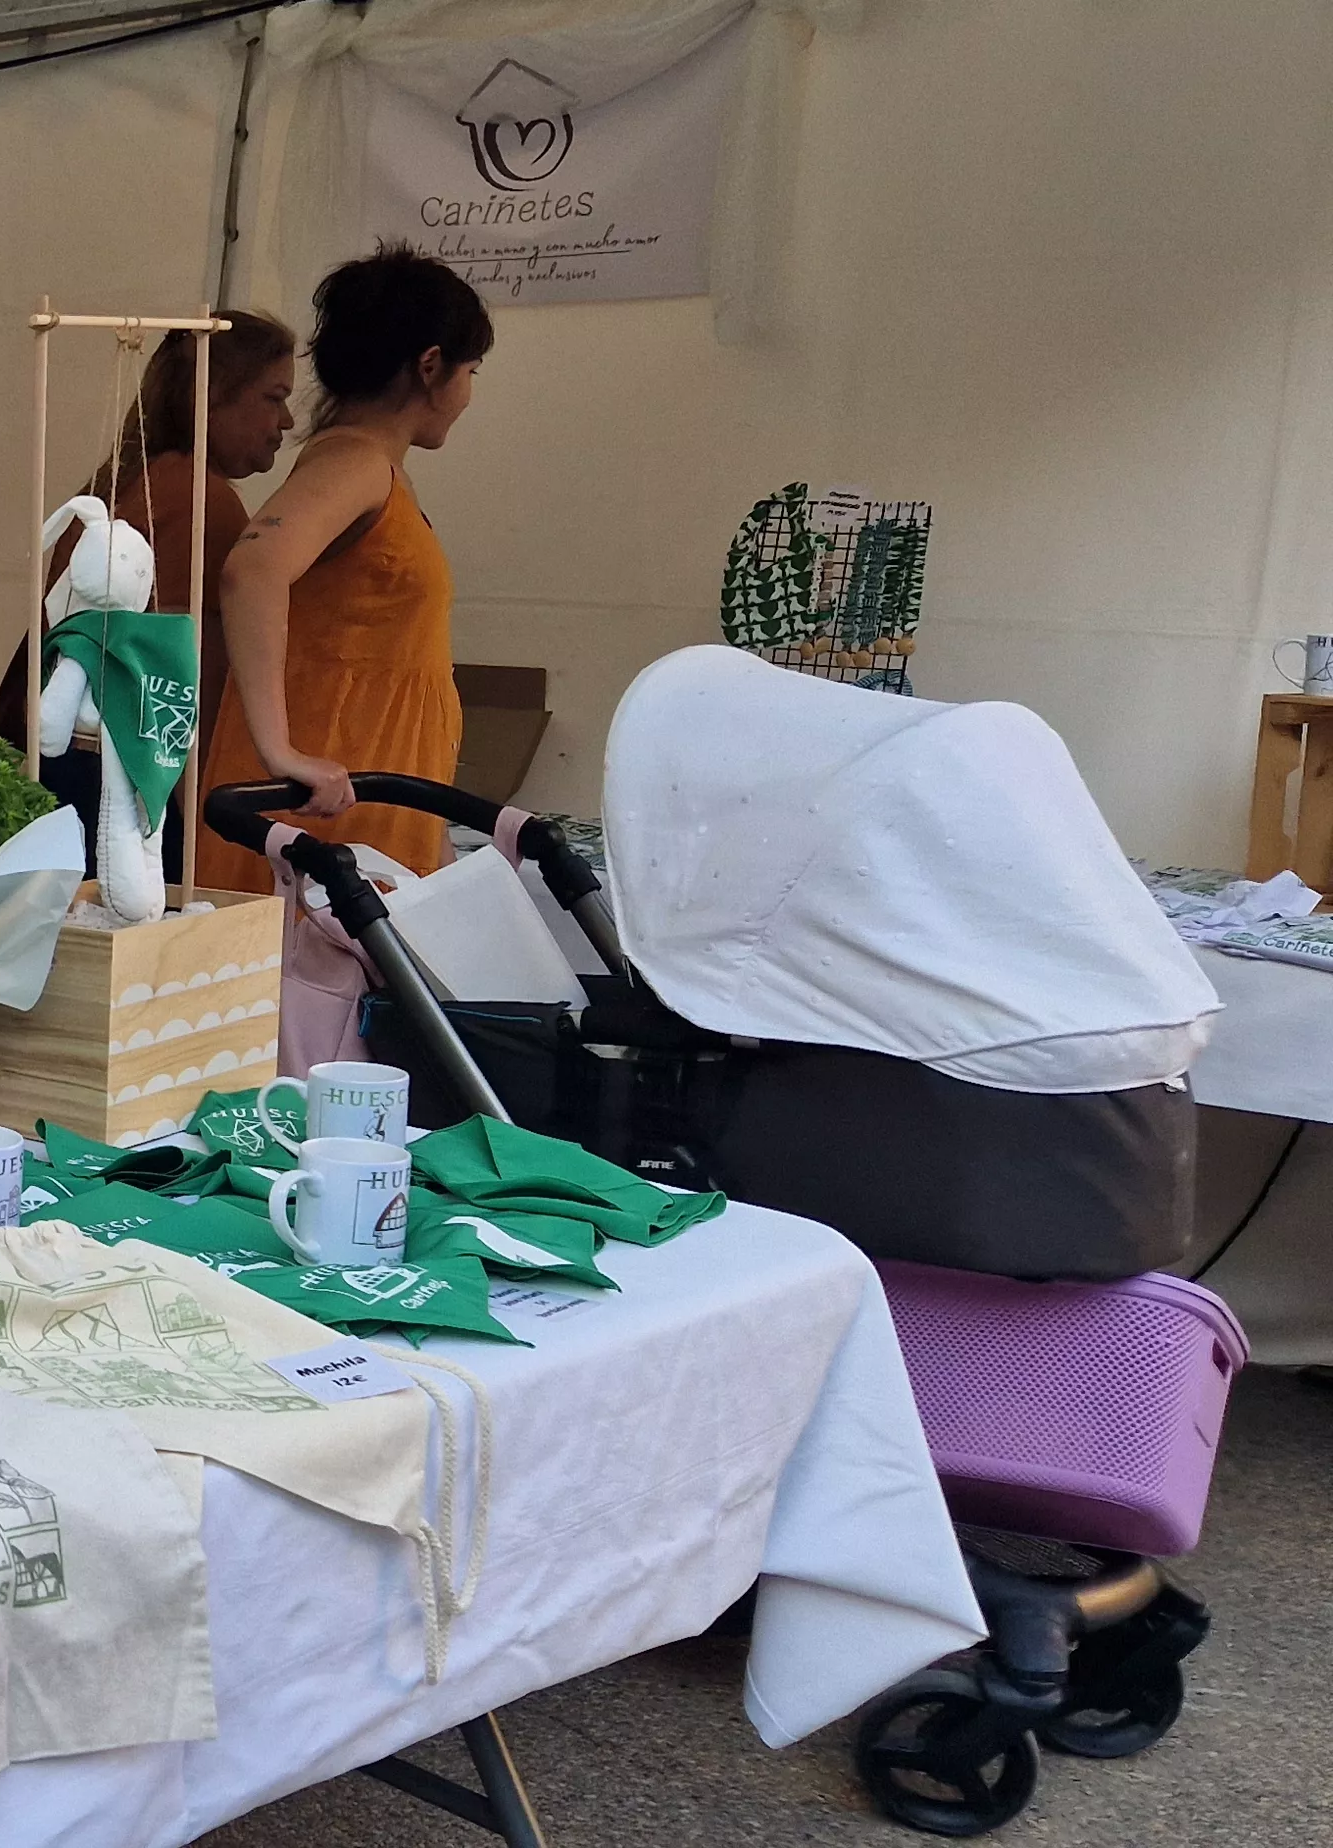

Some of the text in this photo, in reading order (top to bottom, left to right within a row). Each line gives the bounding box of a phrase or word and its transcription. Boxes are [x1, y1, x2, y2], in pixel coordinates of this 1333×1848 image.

[420, 190, 595, 229] Cariñetes
[494, 244, 527, 256] mano
[527, 243, 540, 270] y
[545, 242, 569, 252] con
[573, 223, 621, 250] mucho
[624, 233, 662, 249] amor
[512, 274, 523, 297] y
[295, 1354, 368, 1378] Mochila
[332, 1373, 369, 1388] 12€
